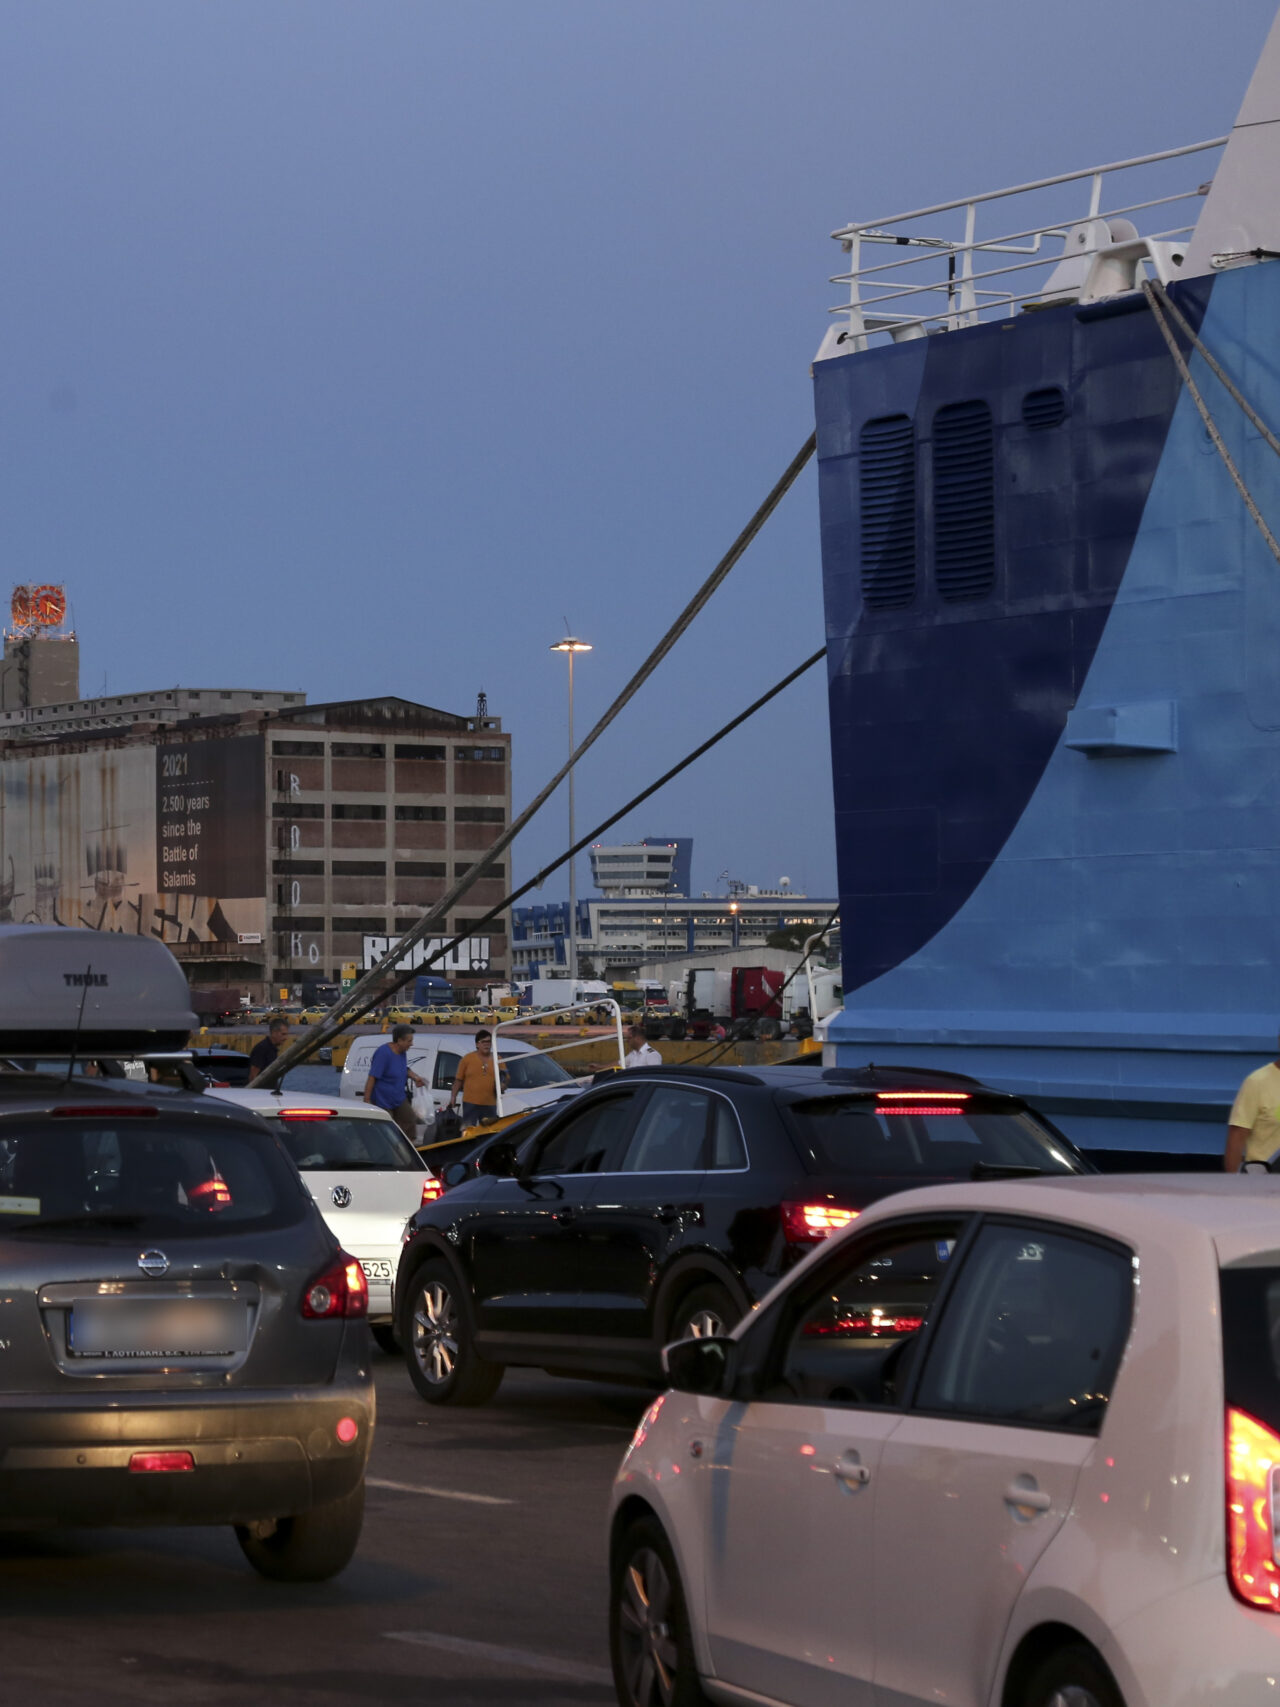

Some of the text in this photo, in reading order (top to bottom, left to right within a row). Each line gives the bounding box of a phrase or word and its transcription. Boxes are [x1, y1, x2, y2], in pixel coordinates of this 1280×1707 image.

[163, 753, 188, 776] 2021
[163, 795, 210, 815] 2.500 years
[163, 819, 201, 837] since the
[163, 843, 198, 862] Battle of
[163, 869, 196, 887] Salamis
[63, 974, 108, 987] THULE
[342, 979, 351, 987] E2
